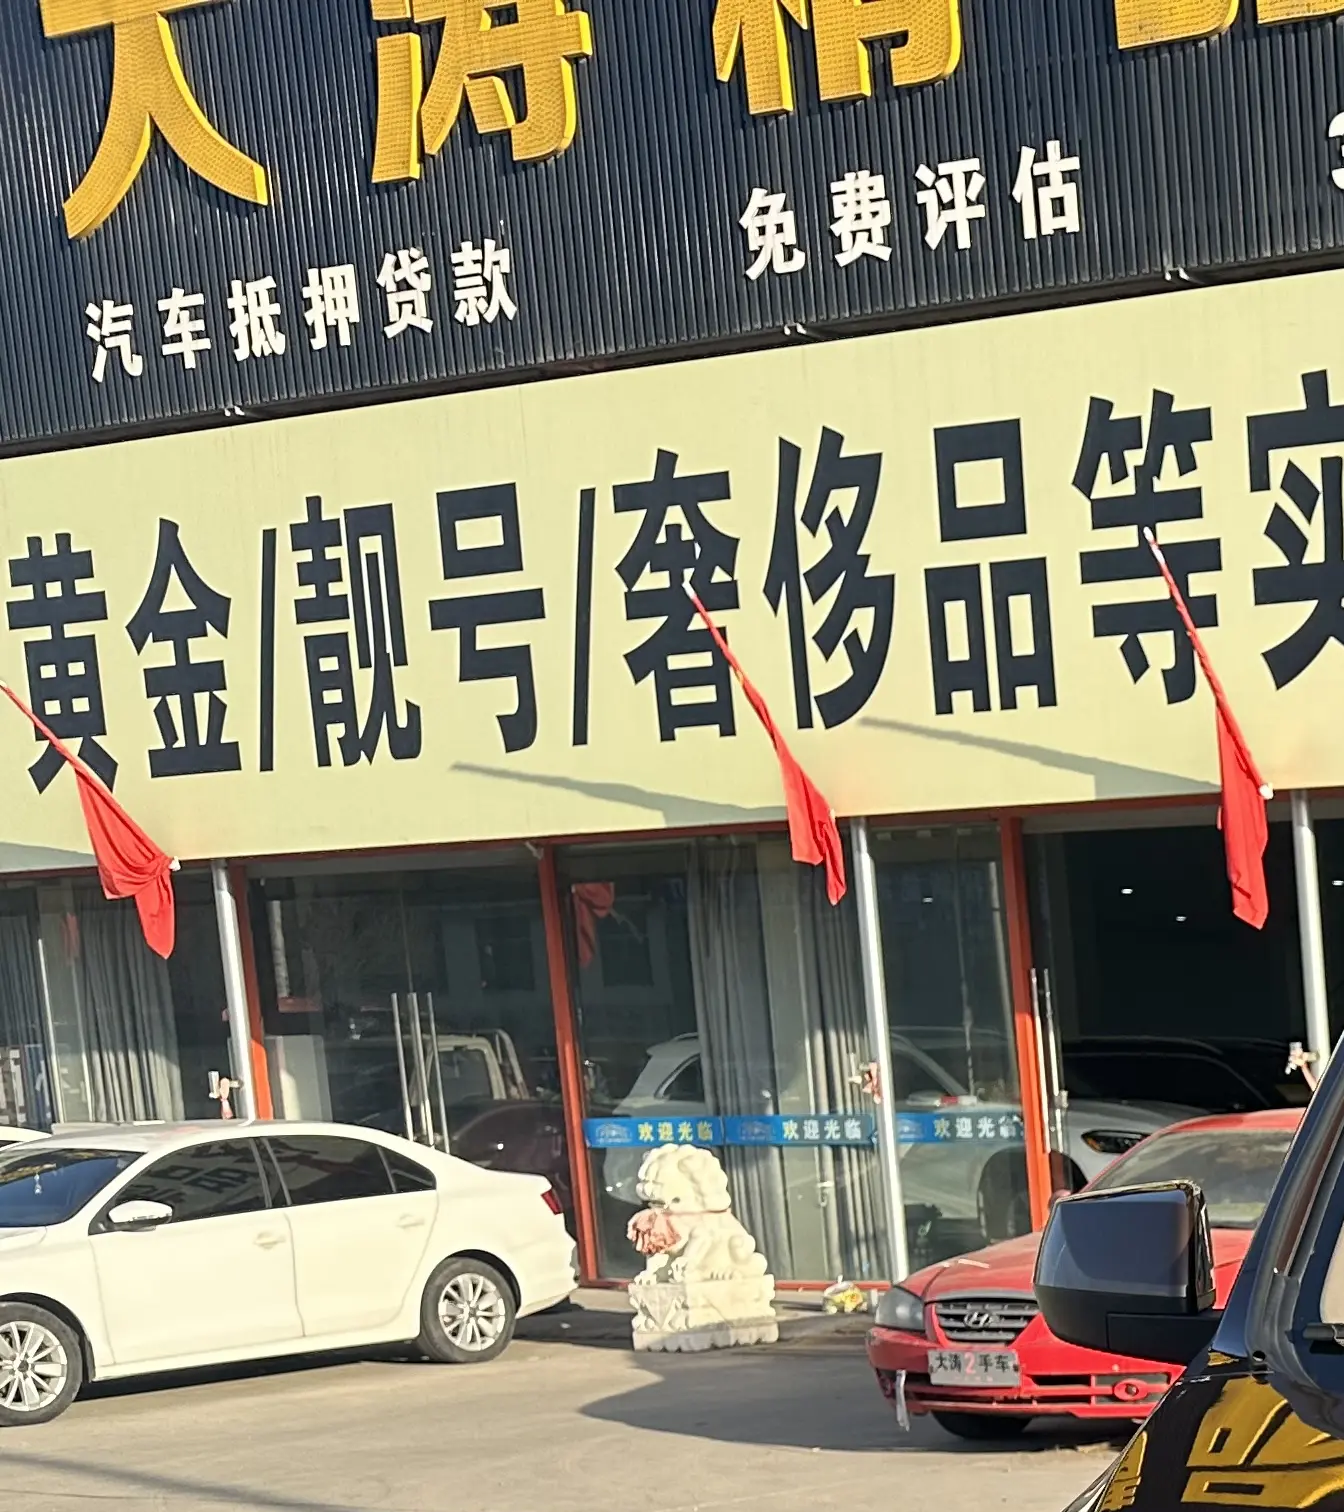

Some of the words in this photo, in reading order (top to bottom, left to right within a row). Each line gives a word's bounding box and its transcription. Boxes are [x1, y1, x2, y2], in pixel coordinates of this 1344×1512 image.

[86, 239, 518, 382] 汽车抵押贷款
[739, 141, 1081, 280] 免费评估
[637, 1120, 713, 1142] 欢迎光临
[782, 1120, 862, 1141] 欢迎光临
[935, 1352, 1010, 1374] 大涛2手车
